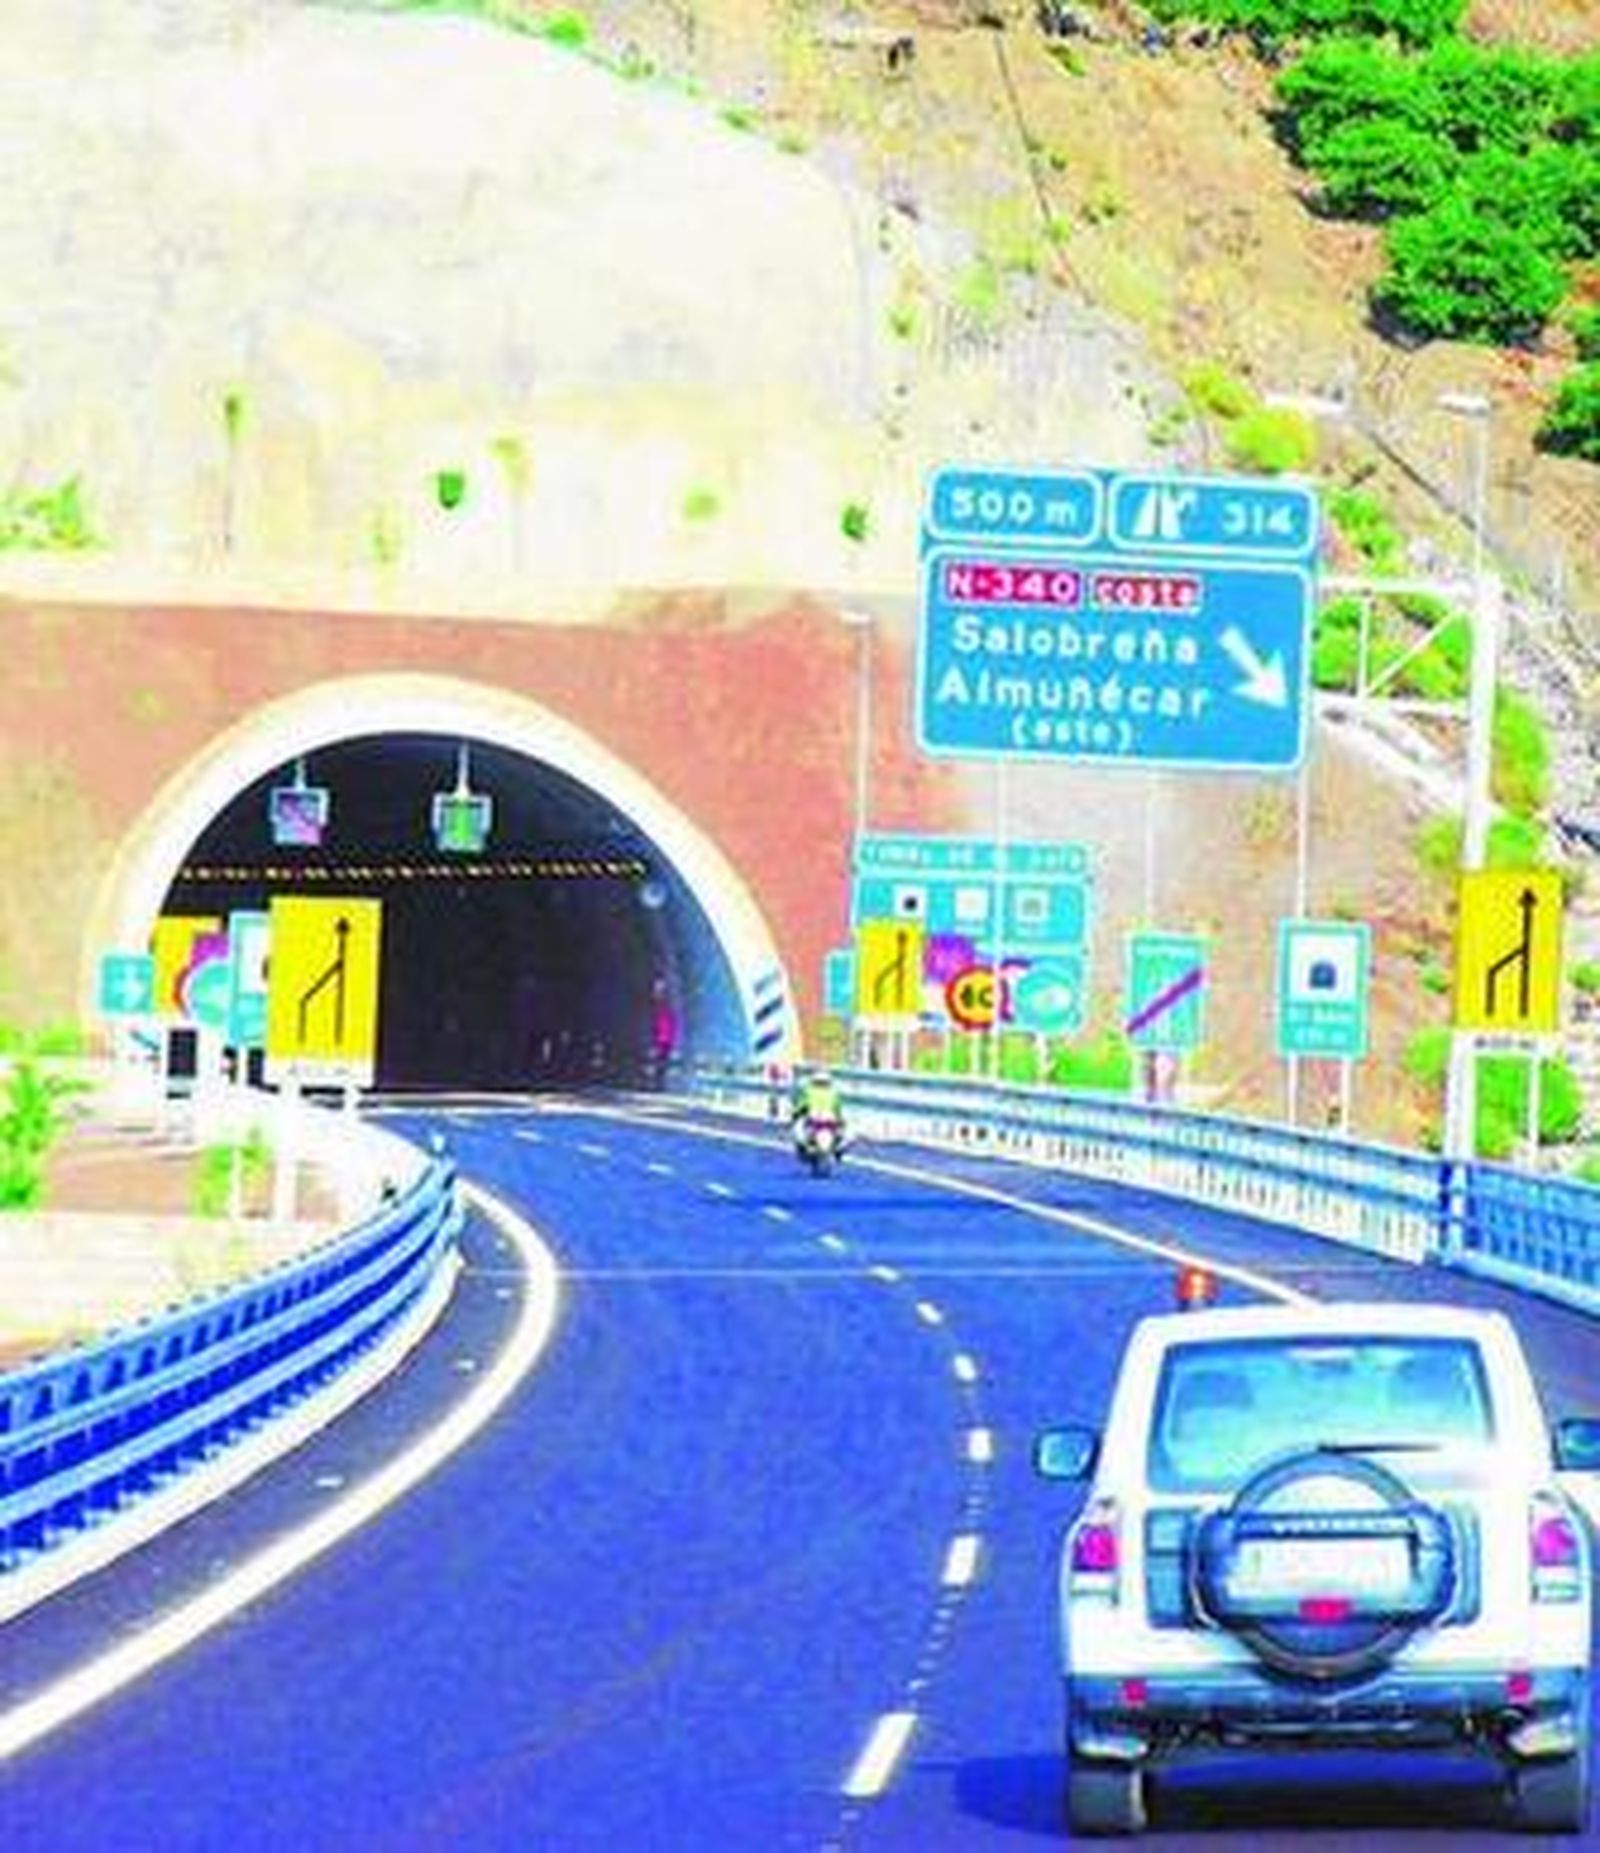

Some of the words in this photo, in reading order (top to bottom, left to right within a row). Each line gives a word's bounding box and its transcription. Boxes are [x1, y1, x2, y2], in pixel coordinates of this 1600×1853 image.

[951, 487, 1034, 524] 500
[1045, 501, 1078, 528] m
[1222, 503, 1293, 535] 314
[949, 569, 1078, 602] N-340
[952, 614, 1198, 665] Salobreña
[937, 665, 1211, 719] Almuñécar
